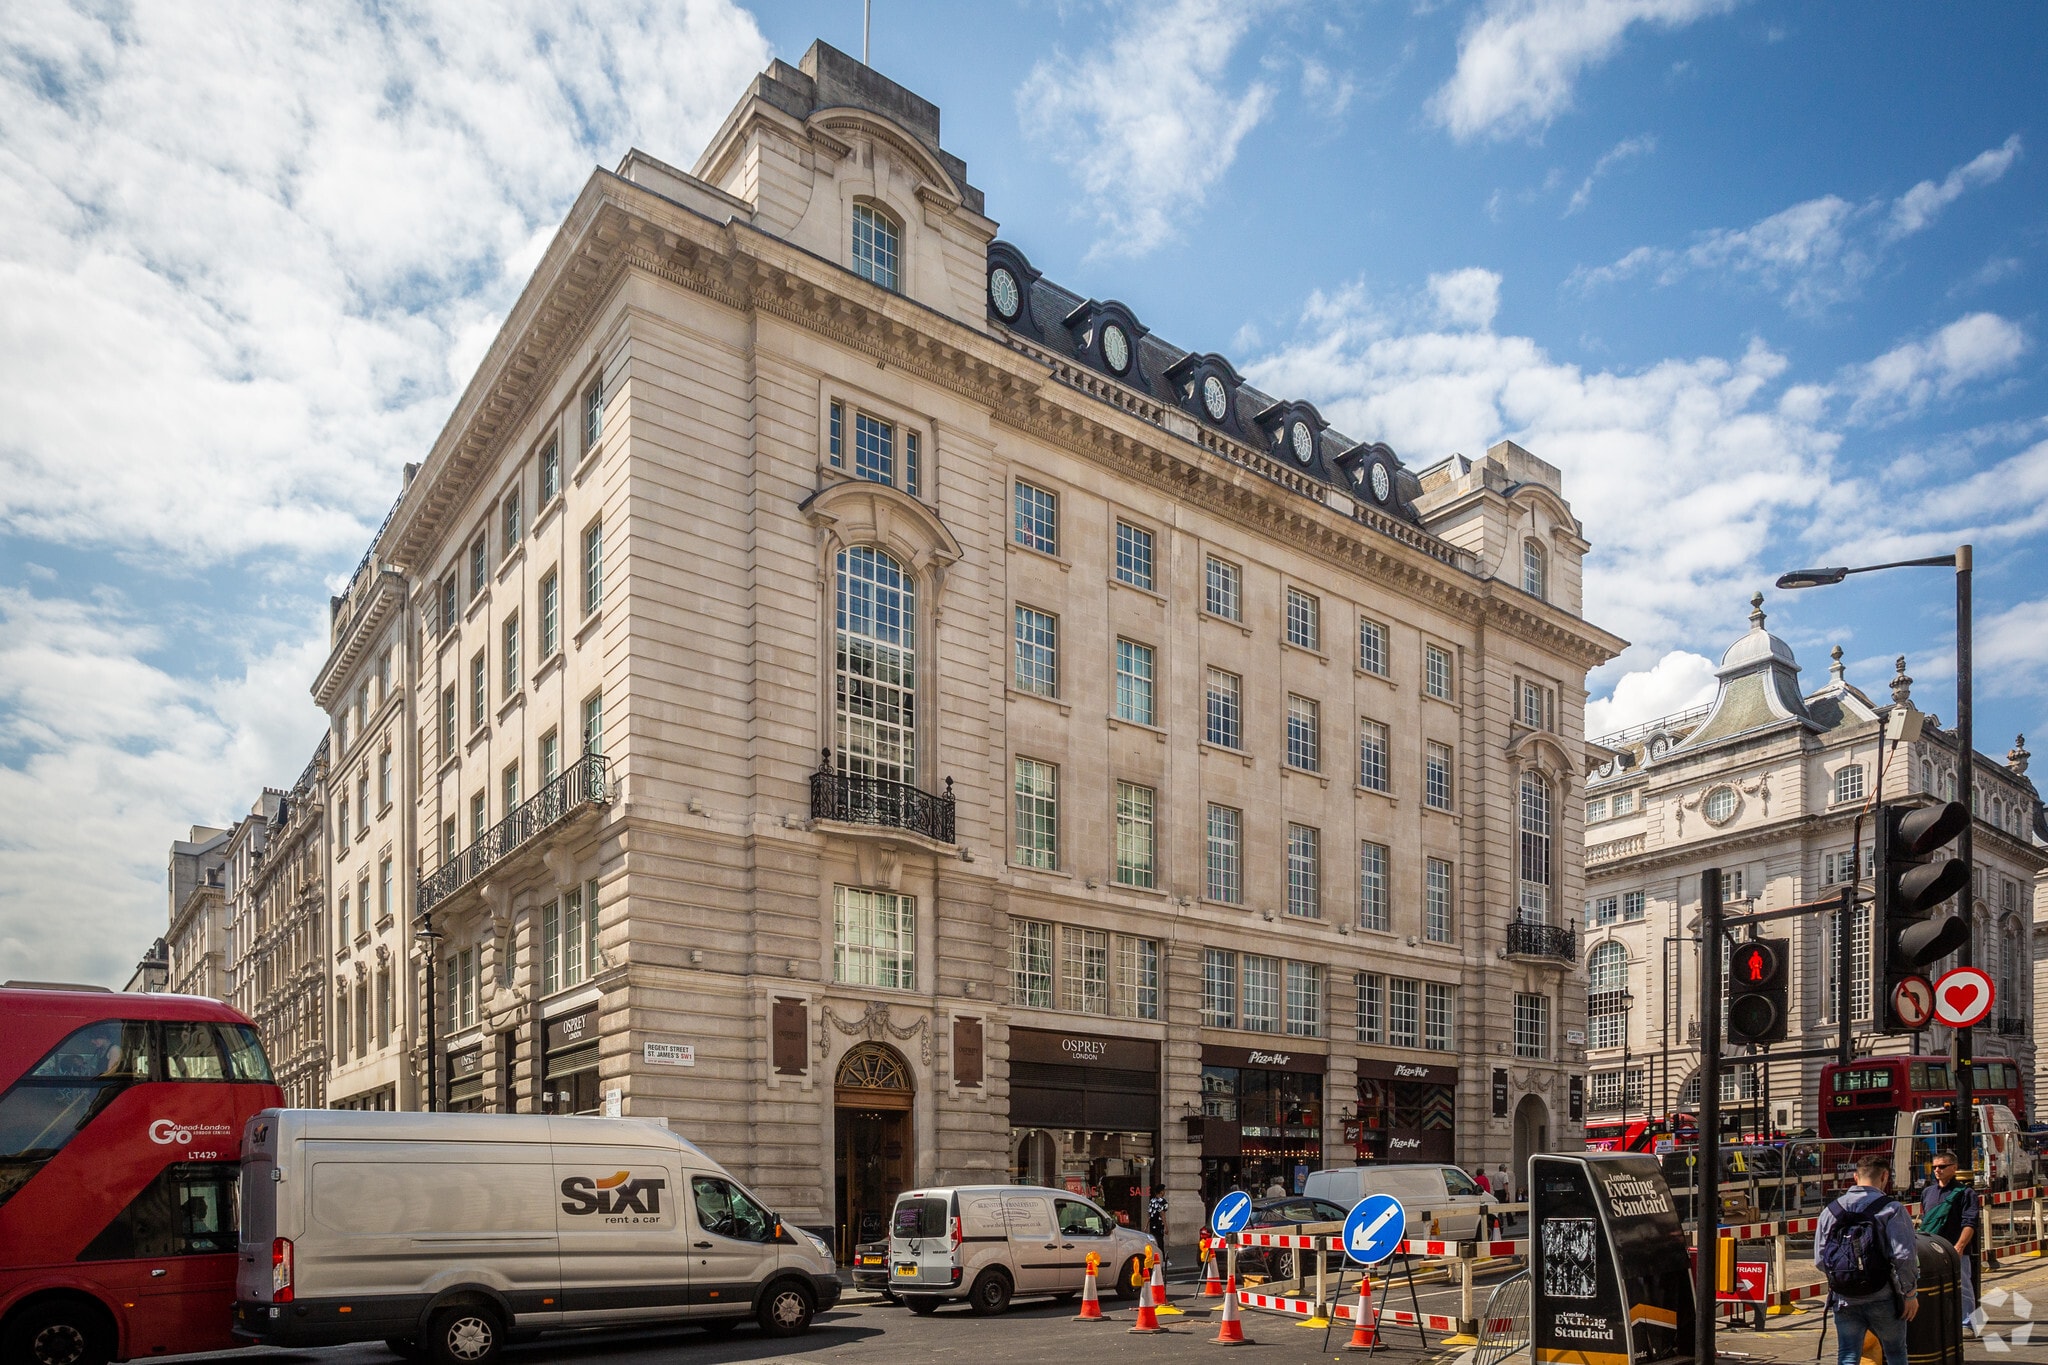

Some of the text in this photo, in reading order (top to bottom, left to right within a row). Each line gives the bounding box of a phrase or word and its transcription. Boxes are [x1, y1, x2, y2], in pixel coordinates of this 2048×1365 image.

[563, 1014, 587, 1034] OSPREY
[568, 1032, 582, 1041] LONDON
[647, 1043, 689, 1053] REGENT STREET
[1062, 1038, 1107, 1054] OSPREY
[460, 1052, 477, 1067] OSPREY
[1072, 1053, 1098, 1061] LONDON
[1248, 1051, 1291, 1066] Pizza Hut
[1394, 1064, 1429, 1077] Pizza Hut
[1836, 1095, 1851, 1106] 94
[148, 1119, 193, 1145] Go
[172, 1123, 231, 1131] Ahead-London
[1345, 1126, 1360, 1134] Pizza
[1389, 1137, 1421, 1148] Pizza Hut
[188, 1151, 217, 1160] LT429
[1608, 1172, 1632, 1182] London
[1129, 1186, 1151, 1197] SALE
[1603, 1177, 1657, 1199] Evening
[1611, 1194, 1670, 1218] Standard
[605, 1216, 661, 1224] rent a car
[1555, 1326, 1614, 1341] Standard
